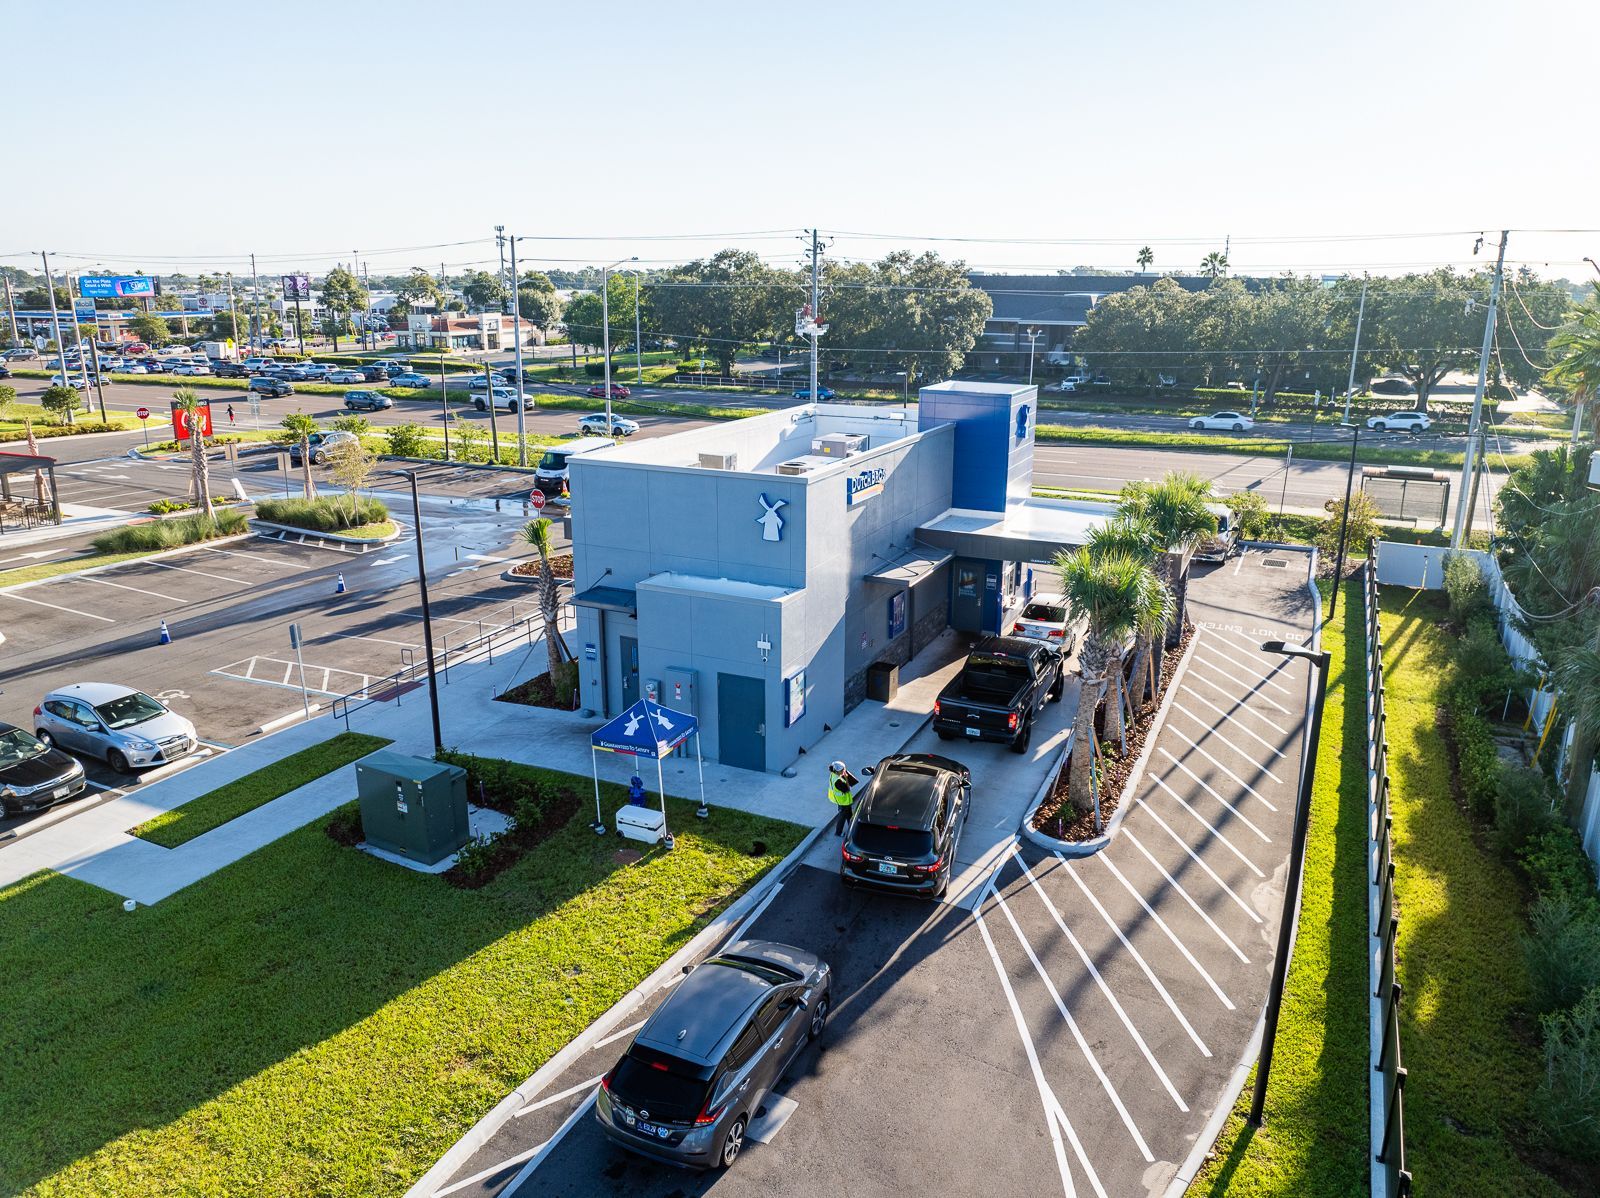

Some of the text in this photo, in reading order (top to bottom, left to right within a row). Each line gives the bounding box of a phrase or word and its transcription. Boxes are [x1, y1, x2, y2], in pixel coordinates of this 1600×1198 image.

[852, 468, 885, 493] DUTCH BROS
[532, 495, 544, 503] STOP
[1198, 621, 1304, 642] DO NOT ENTER
